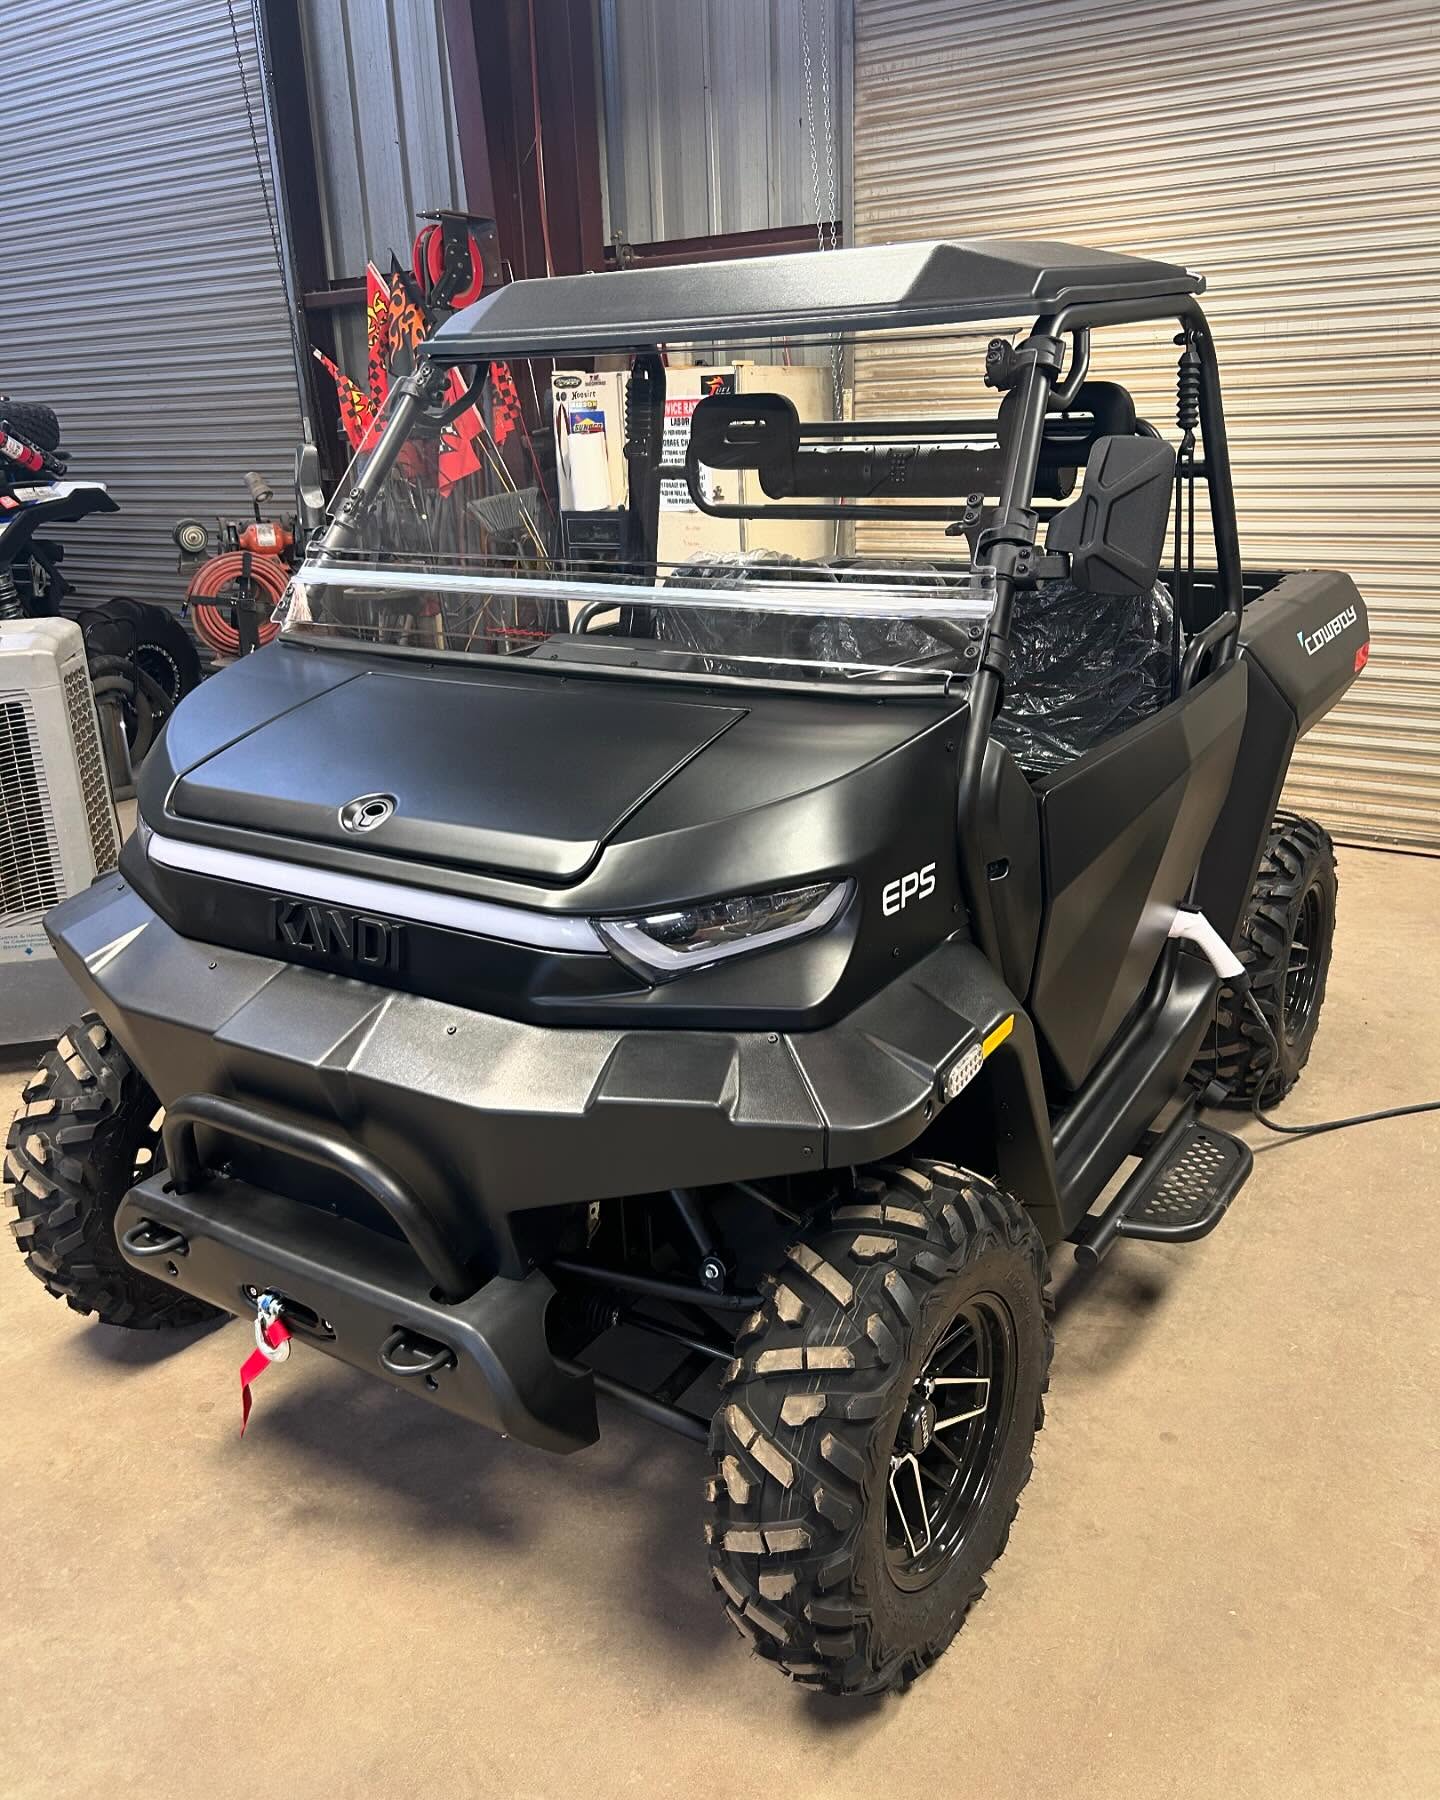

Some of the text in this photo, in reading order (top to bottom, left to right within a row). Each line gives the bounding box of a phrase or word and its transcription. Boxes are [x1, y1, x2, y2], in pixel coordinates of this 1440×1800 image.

[573, 423, 603, 433] SUNOCO
[1304, 604, 1357, 656] COWBOY
[882, 862, 936, 916] EPS
[268, 897, 407, 971] KANDI
